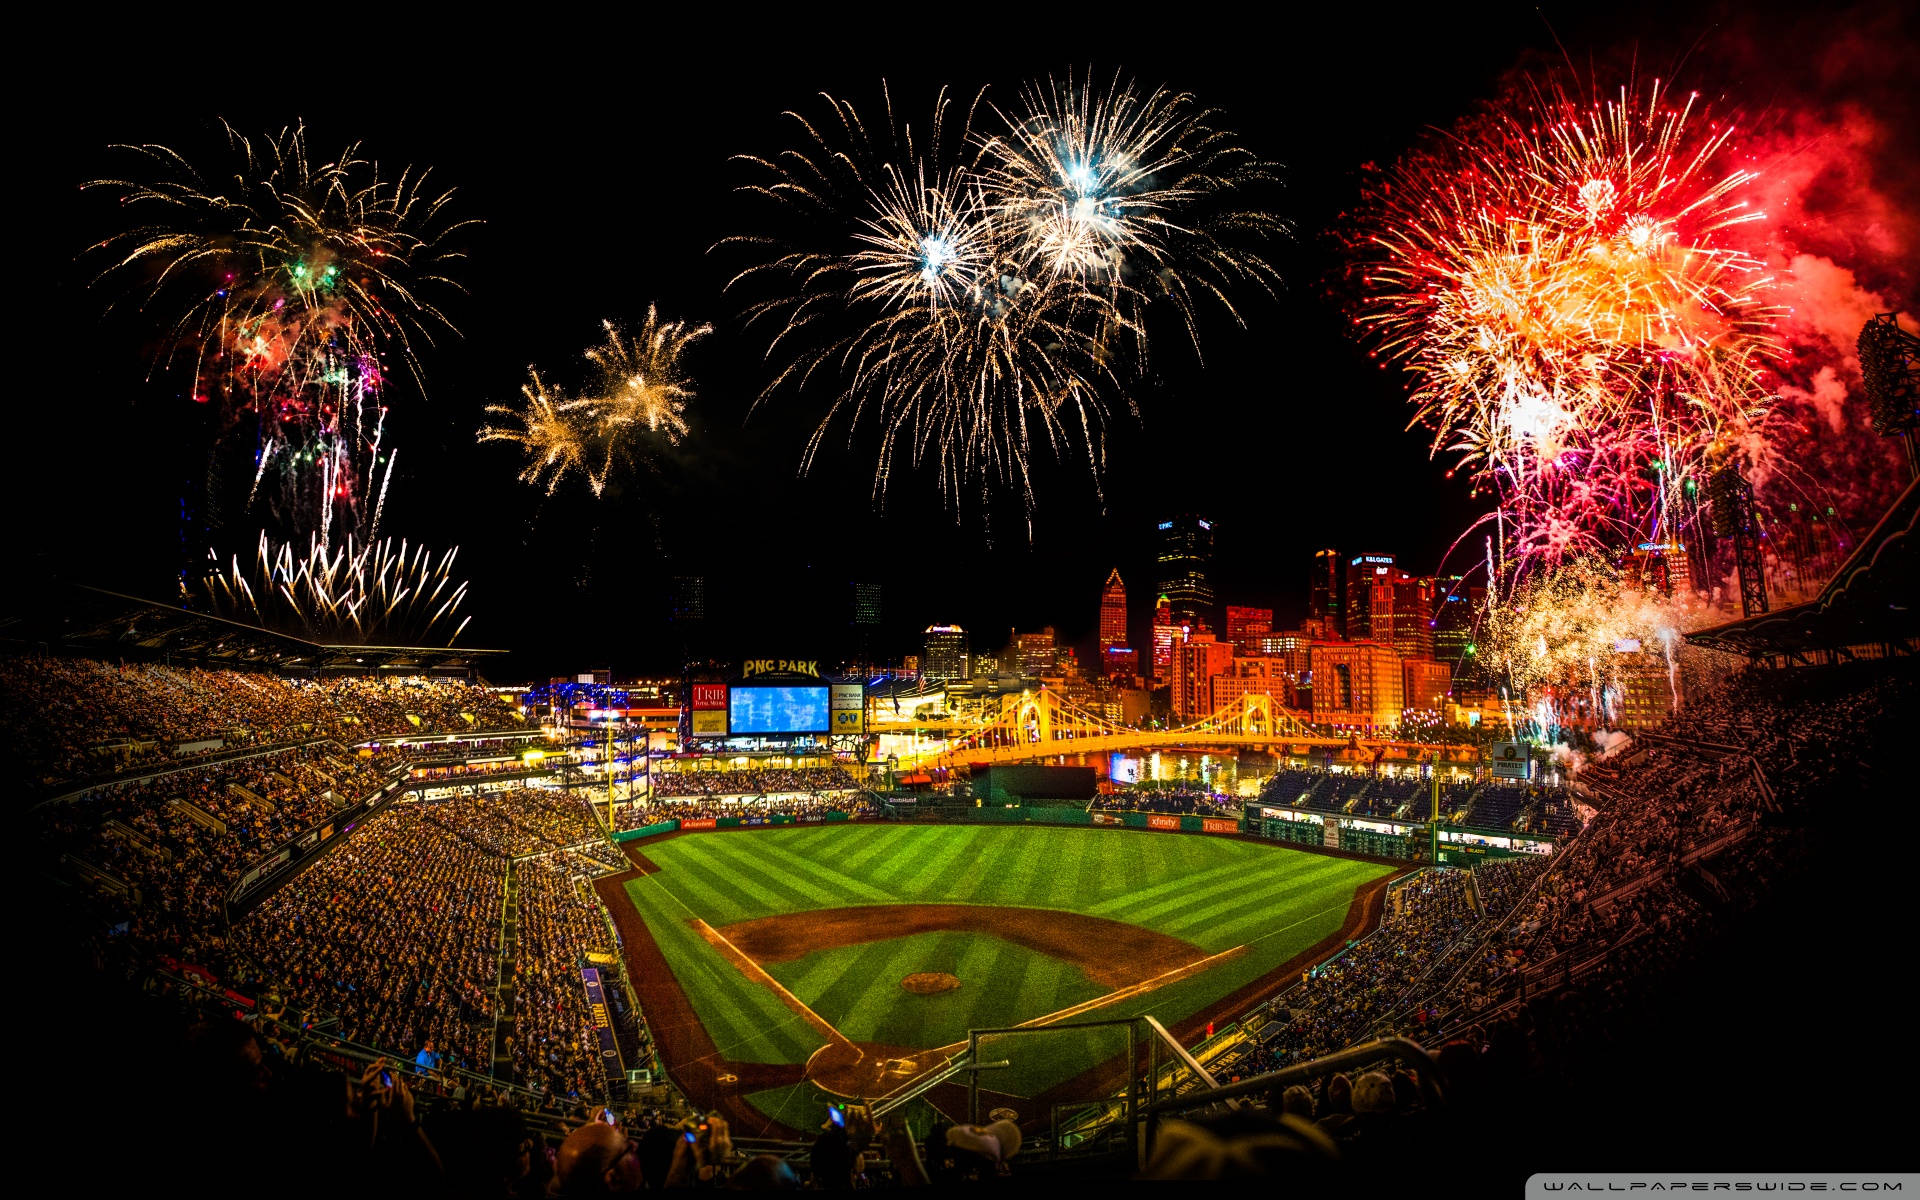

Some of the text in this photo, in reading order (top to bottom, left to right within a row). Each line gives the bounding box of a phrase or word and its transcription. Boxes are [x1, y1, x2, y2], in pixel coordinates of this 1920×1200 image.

[743, 659, 820, 679] PNC PARK
[694, 687, 724, 700] TRIB
[1151, 817, 1176, 828] xfinity
[1266, 820, 1293, 829] NATIONAL
[1346, 831, 1404, 844] AMERICAN LEAGUE
[592, 1003, 609, 1028] PIRATES
